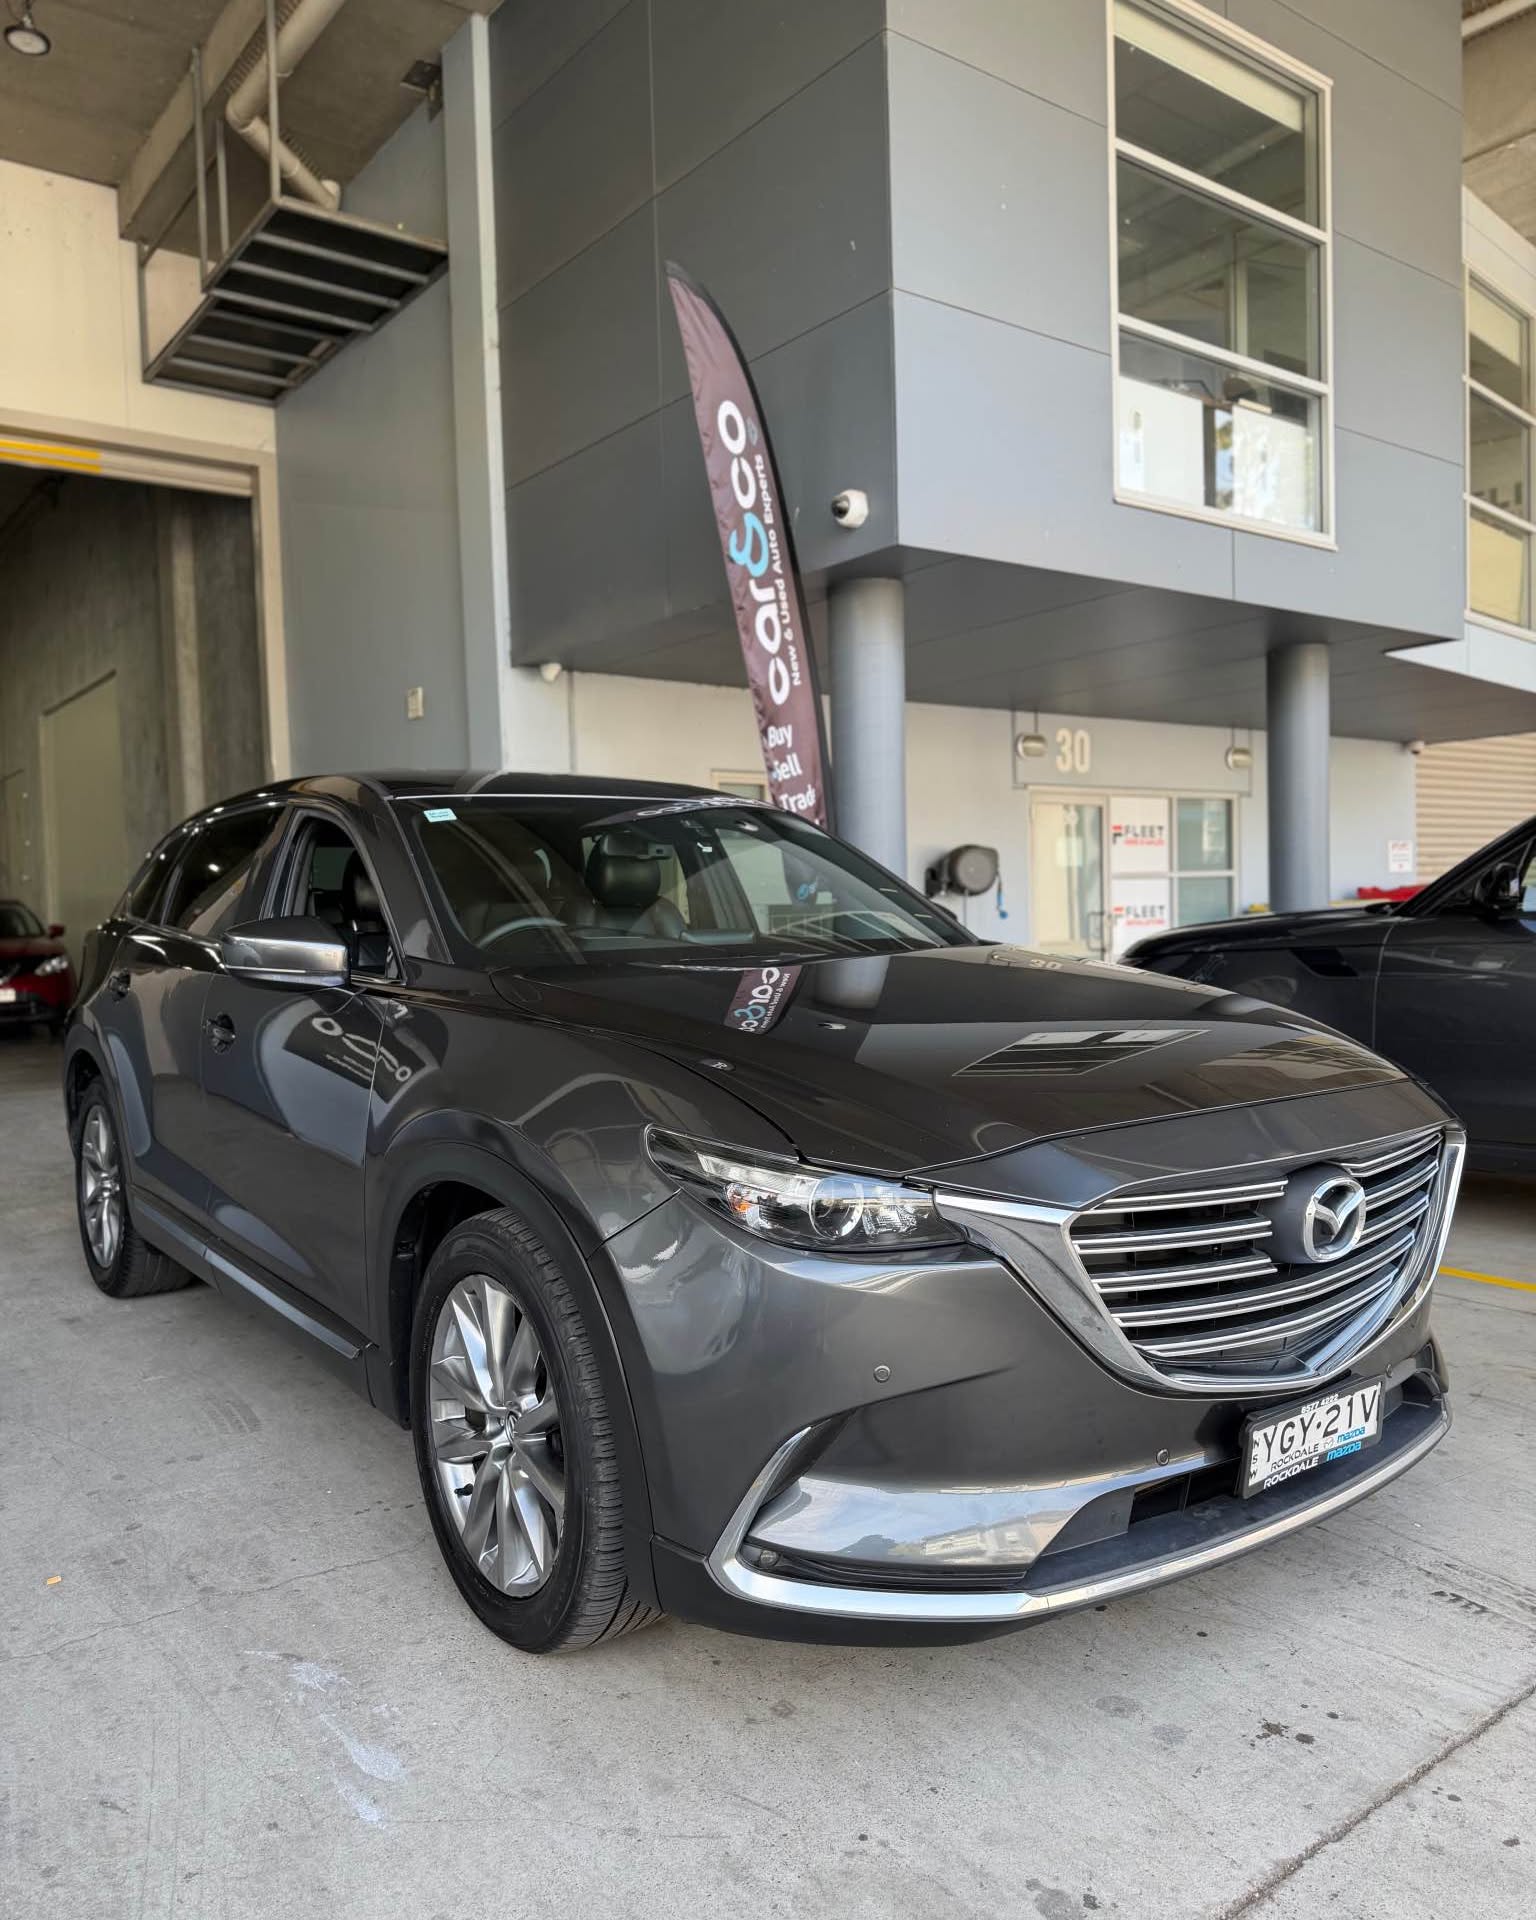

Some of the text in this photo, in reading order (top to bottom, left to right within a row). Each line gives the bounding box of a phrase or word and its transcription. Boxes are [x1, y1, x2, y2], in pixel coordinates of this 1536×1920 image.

[755, 454, 774, 524] Experts
[767, 529, 783, 574] Auto
[774, 579, 791, 624] Used
[787, 645, 802, 686] New
[767, 724, 793, 749] Buy
[1055, 727, 1090, 774] 30
[779, 784, 817, 813] Trad
[1124, 825, 1164, 839] FLEET
[1125, 905, 1165, 919] FLEET
[1263, 1456, 1319, 1489] ROCKDALE
[1271, 1443, 1319, 1472] ROCKDALE
